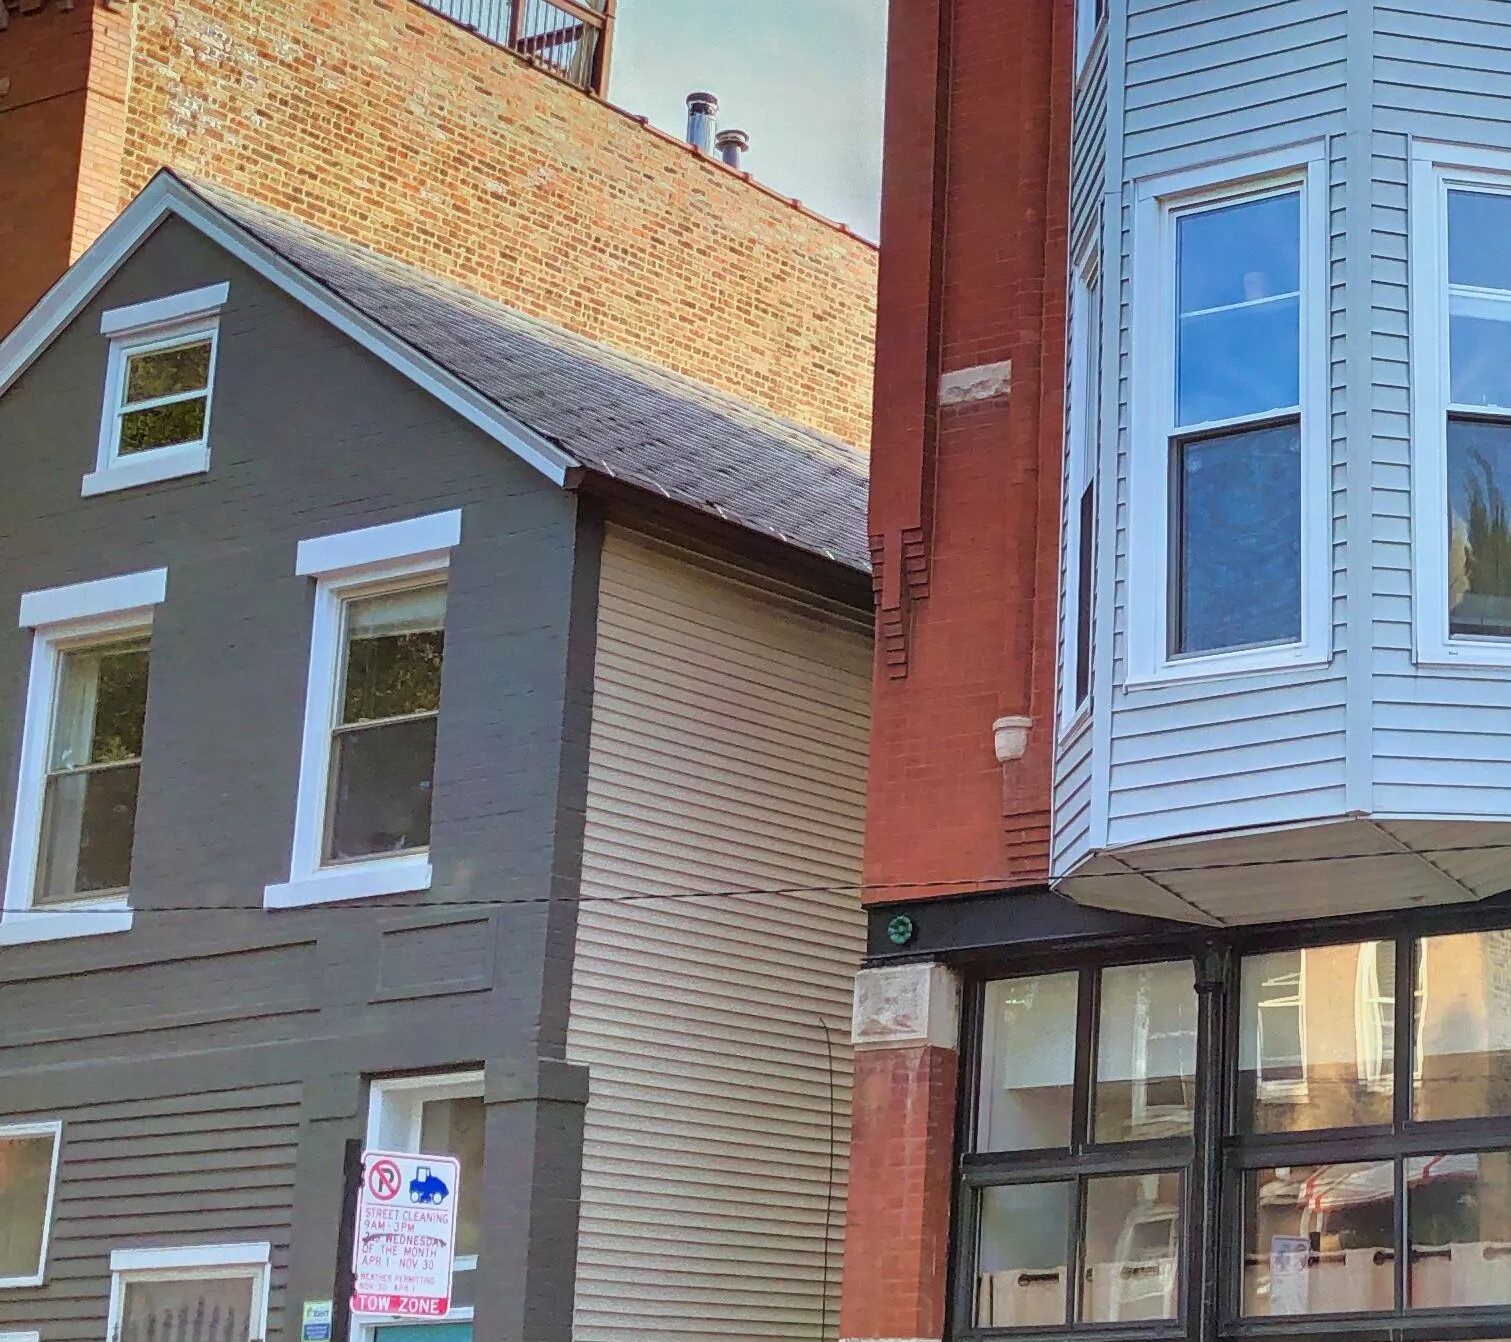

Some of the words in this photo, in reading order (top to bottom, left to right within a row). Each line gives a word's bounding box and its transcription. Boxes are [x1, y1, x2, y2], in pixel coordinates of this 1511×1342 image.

[365, 1208, 399, 1220] STREET
[402, 1210, 448, 1224] CLEANING
[364, 1219, 386, 1230] 9AM
[394, 1221, 415, 1232] 3PM
[362, 1244, 374, 1254] OF
[381, 1245, 398, 1256] THE
[404, 1247, 437, 1258] MONTH
[361, 1255, 382, 1266] APR
[399, 1258, 418, 1269] NOV
[422, 1259, 434, 1270] 30
[360, 1273, 392, 1282] WEATHER
[395, 1275, 435, 1284] PERMITTING
[359, 1296, 391, 1311] TOW
[398, 1297, 440, 1314] ZONE
